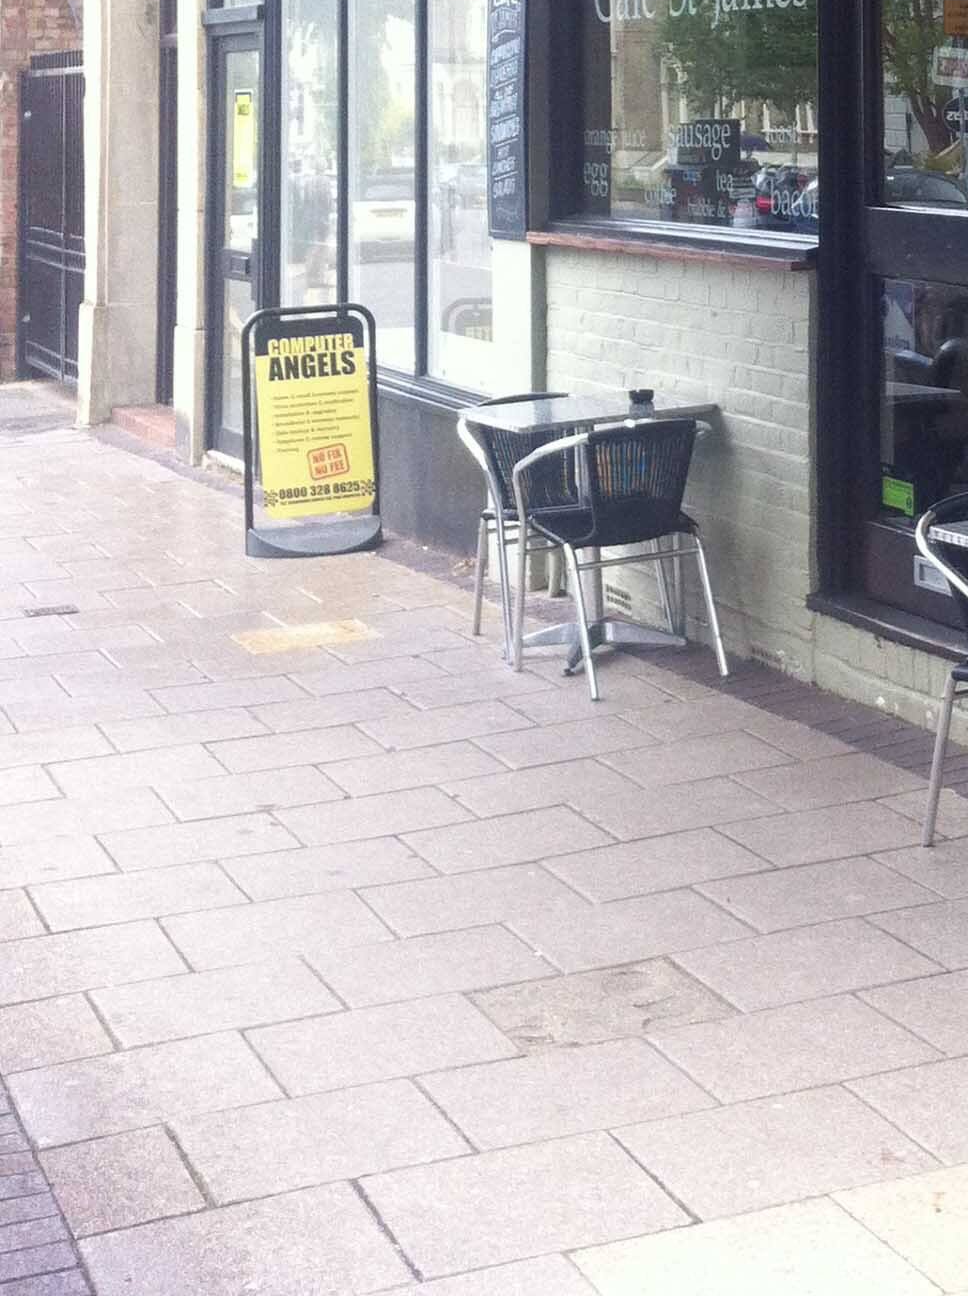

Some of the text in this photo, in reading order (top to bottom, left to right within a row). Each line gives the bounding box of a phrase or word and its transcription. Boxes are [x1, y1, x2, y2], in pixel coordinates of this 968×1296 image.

[668, 122, 731, 161] sausage
[583, 161, 609, 198] egg
[716, 169, 735, 193] tea
[267, 332, 354, 355] COMPUTER
[269, 352, 356, 381] ANGELS
